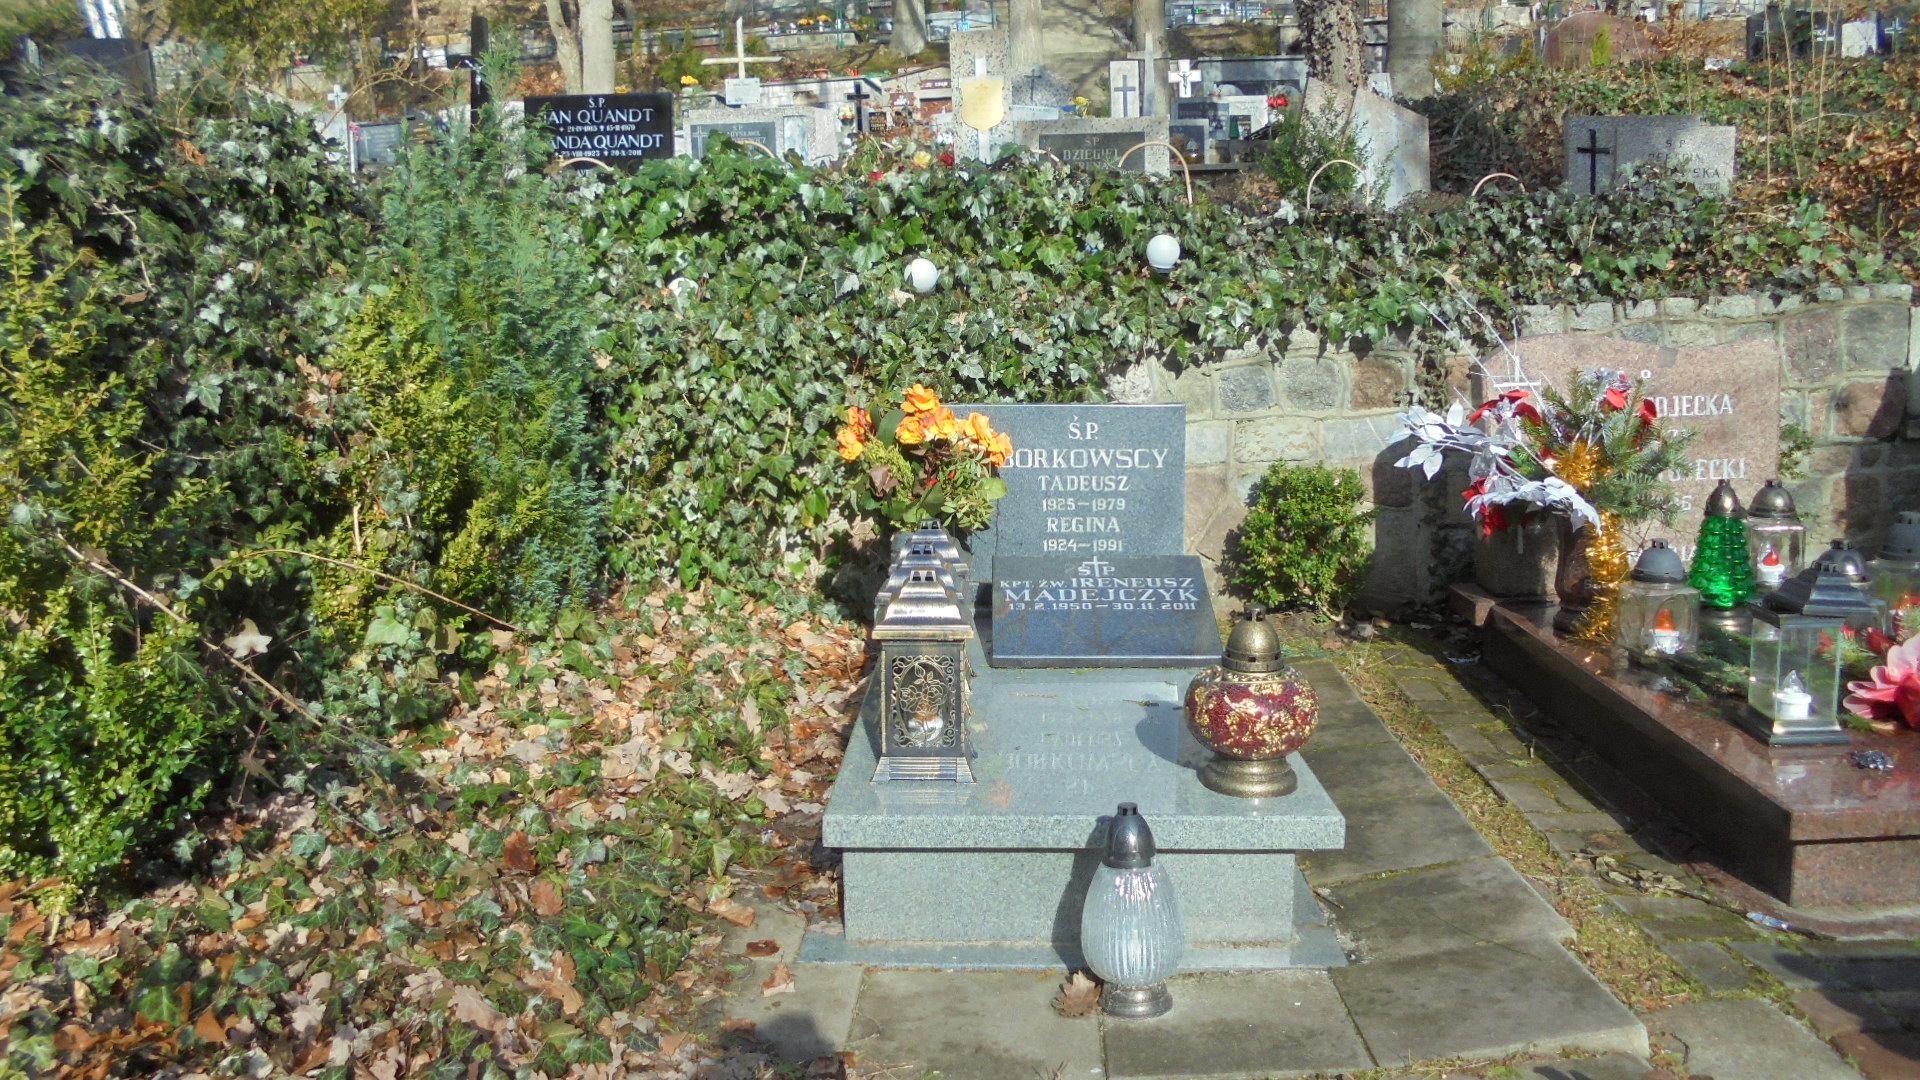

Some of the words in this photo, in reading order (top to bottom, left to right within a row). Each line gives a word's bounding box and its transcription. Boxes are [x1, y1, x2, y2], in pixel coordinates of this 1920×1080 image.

[577, 108, 654, 125] QUANDT
[593, 134, 664, 150] QUANDT
[1038, 475, 1130, 492] TADEUSZ
[1046, 517, 1120, 533] REGINA
[1071, 577, 1194, 588] IRENEUSZ
[1004, 588, 1199, 601] MADEJCZYK
